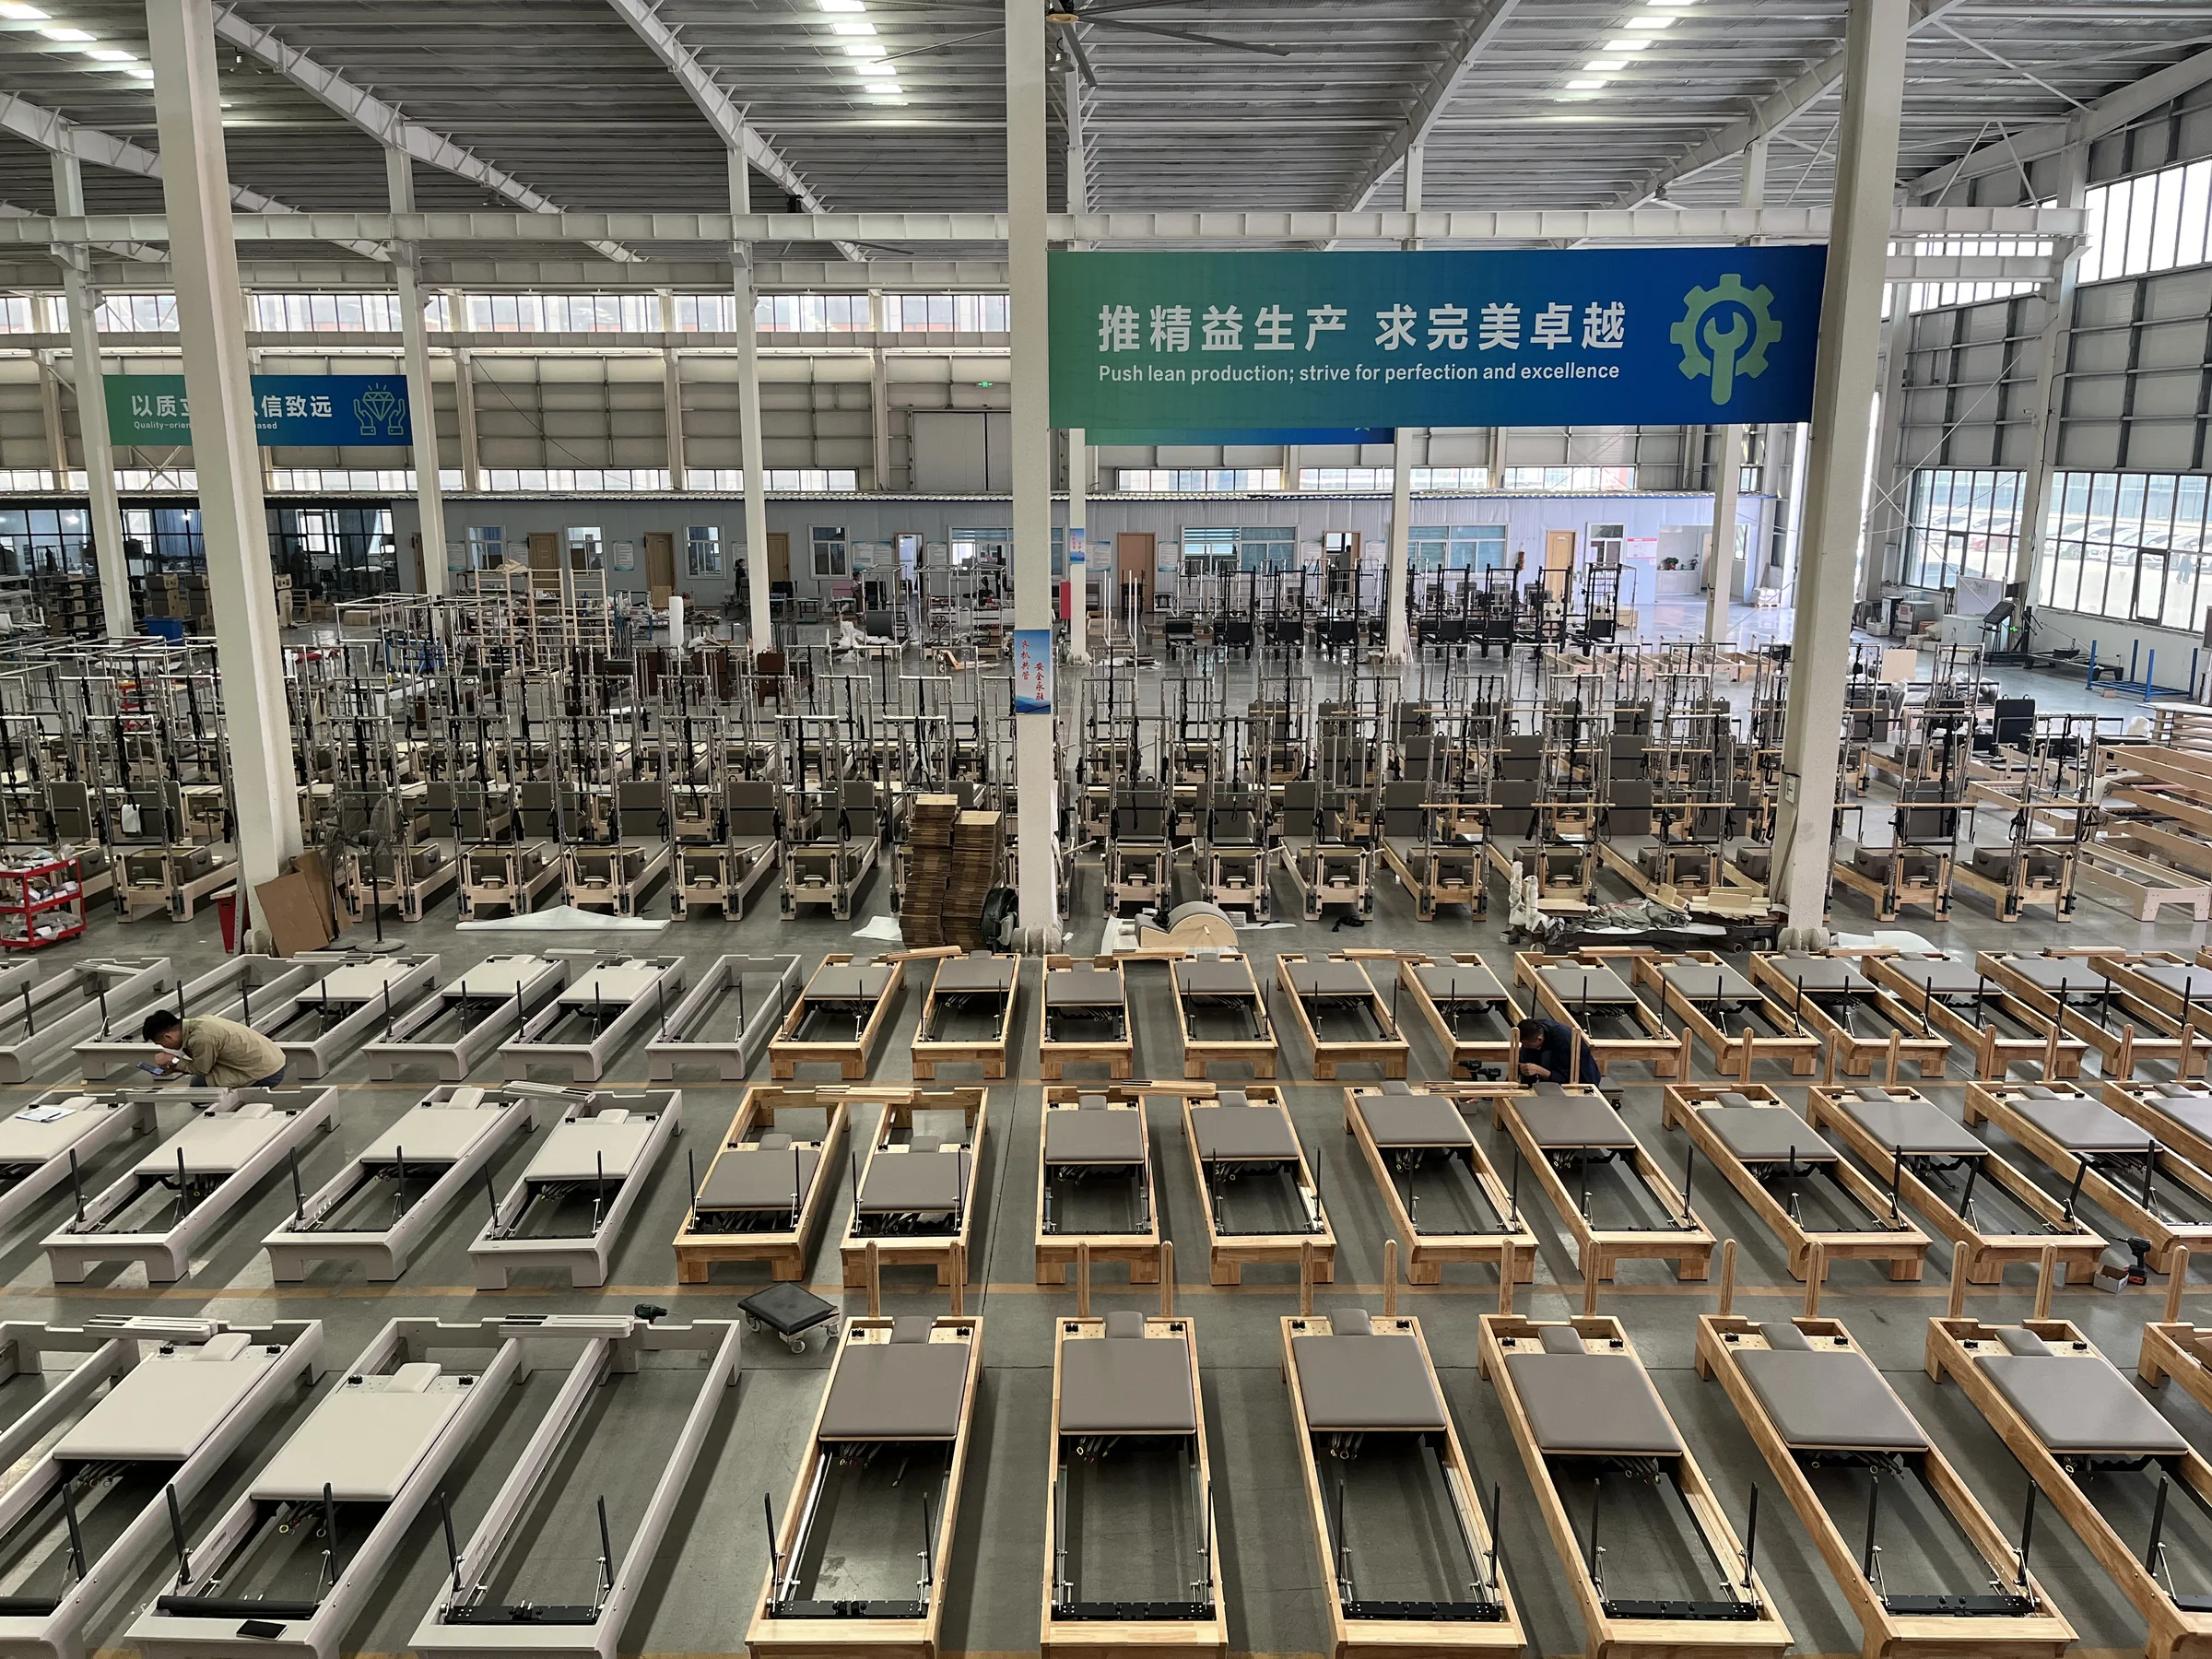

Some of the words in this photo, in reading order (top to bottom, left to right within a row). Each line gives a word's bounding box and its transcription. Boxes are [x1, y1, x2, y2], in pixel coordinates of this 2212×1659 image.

[1099, 304, 1347, 352] 推精益生产
[1375, 301, 1626, 351] 求完美卓越
[1099, 365, 1143, 382] Push
[1148, 365, 1186, 382] lean
[1191, 365, 1294, 385] production;
[1300, 364, 1350, 381] strive
[1355, 364, 1381, 380] for
[1385, 363, 1477, 383] perfection
[1483, 363, 1516, 380] and
[1521, 362, 1619, 379] excellence
[253, 394, 333, 418] 信致远
[134, 420, 191, 430] Quality-orien
[256, 421, 277, 429] ased
